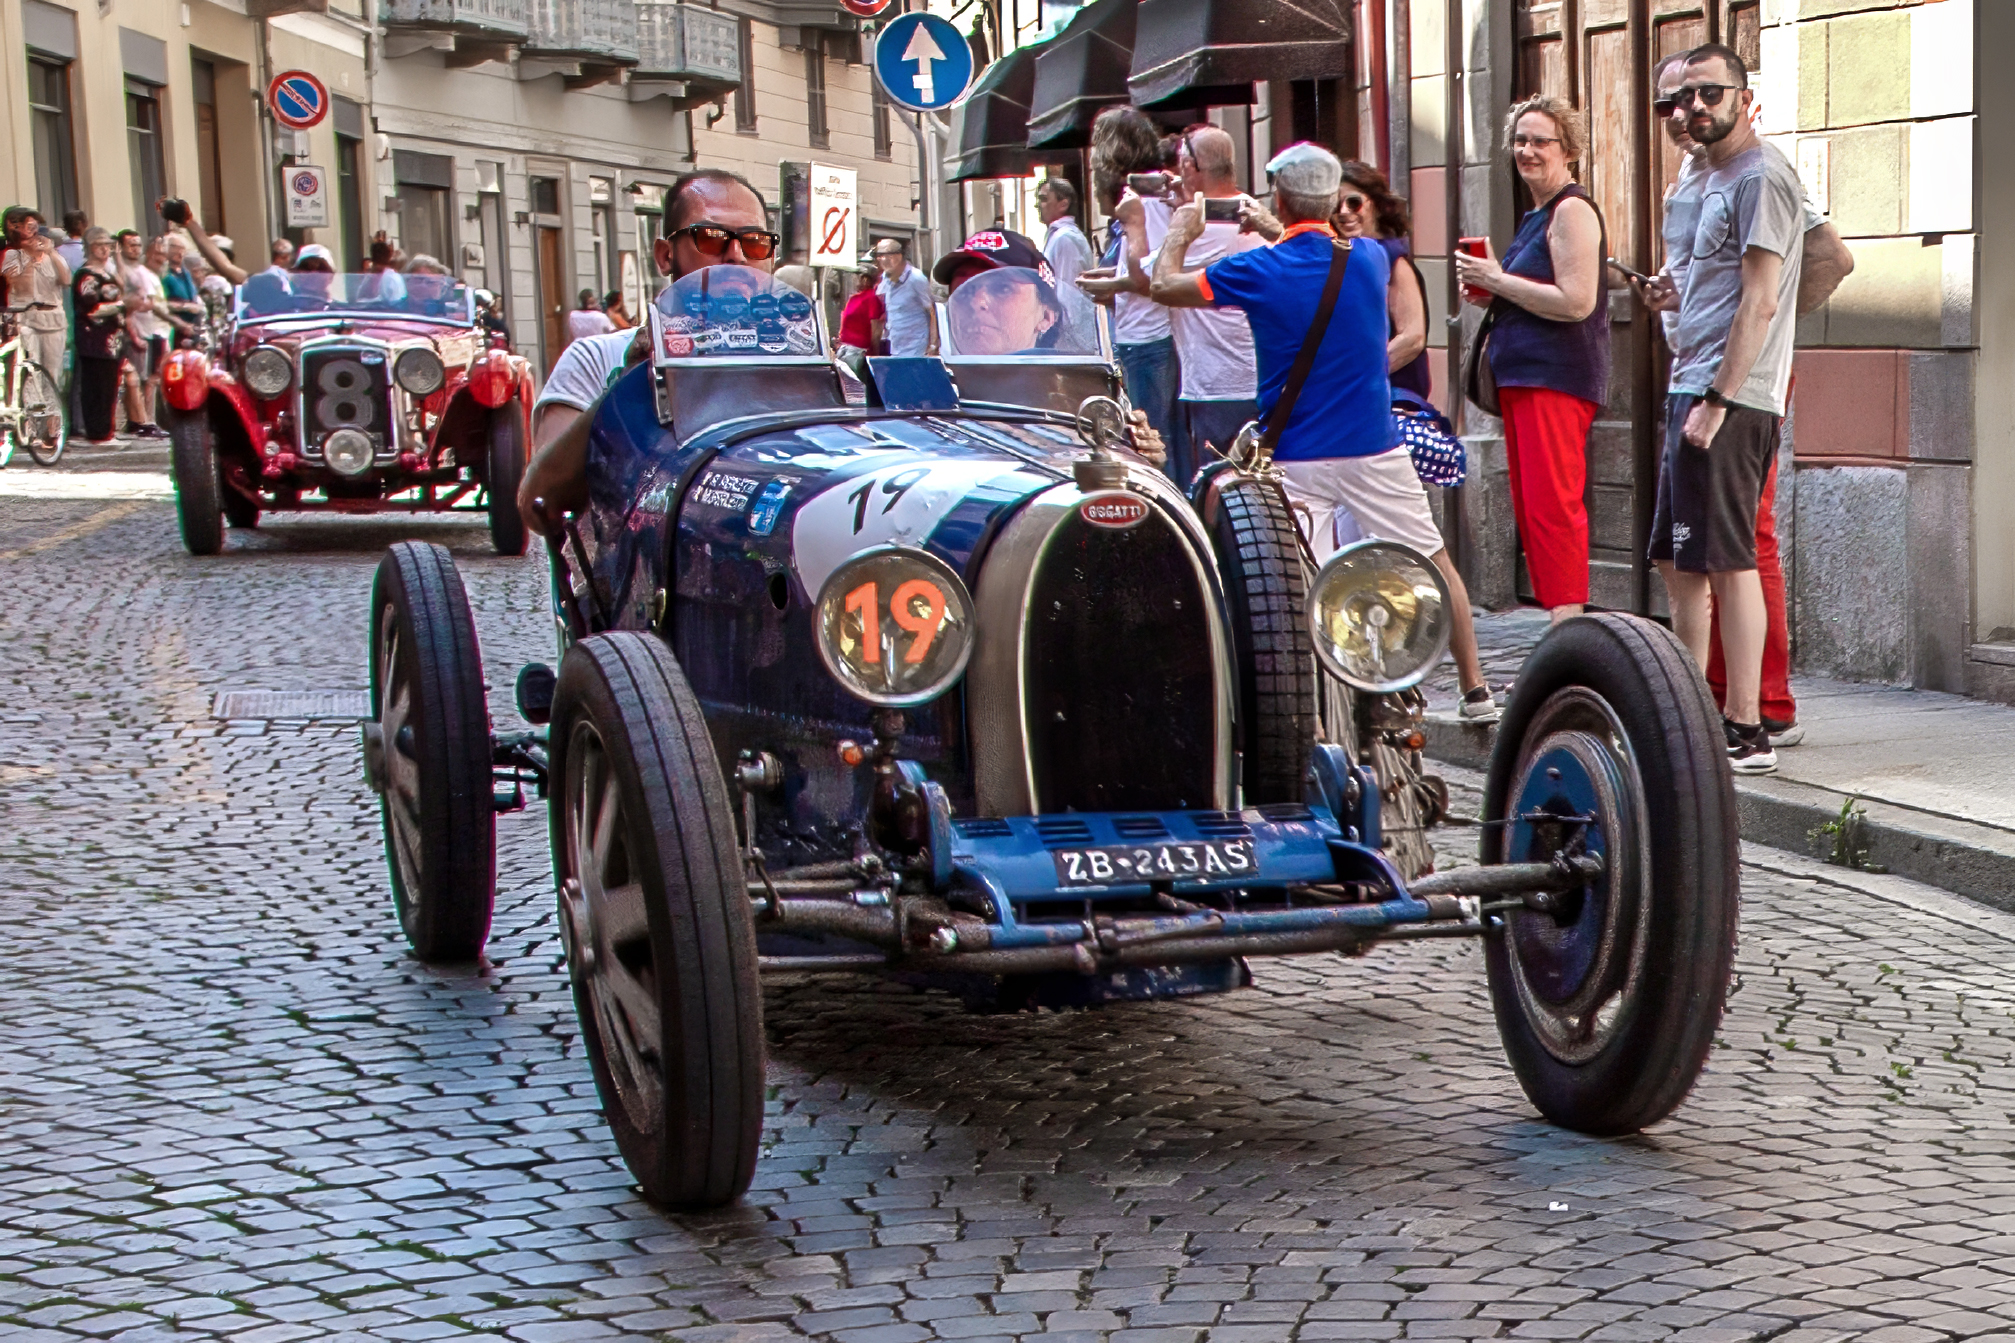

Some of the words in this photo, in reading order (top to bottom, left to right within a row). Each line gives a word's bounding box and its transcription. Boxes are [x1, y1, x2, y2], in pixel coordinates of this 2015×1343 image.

[316, 359, 374, 430] 8
[848, 468, 931, 535] 19
[845, 578, 946, 663] 19
